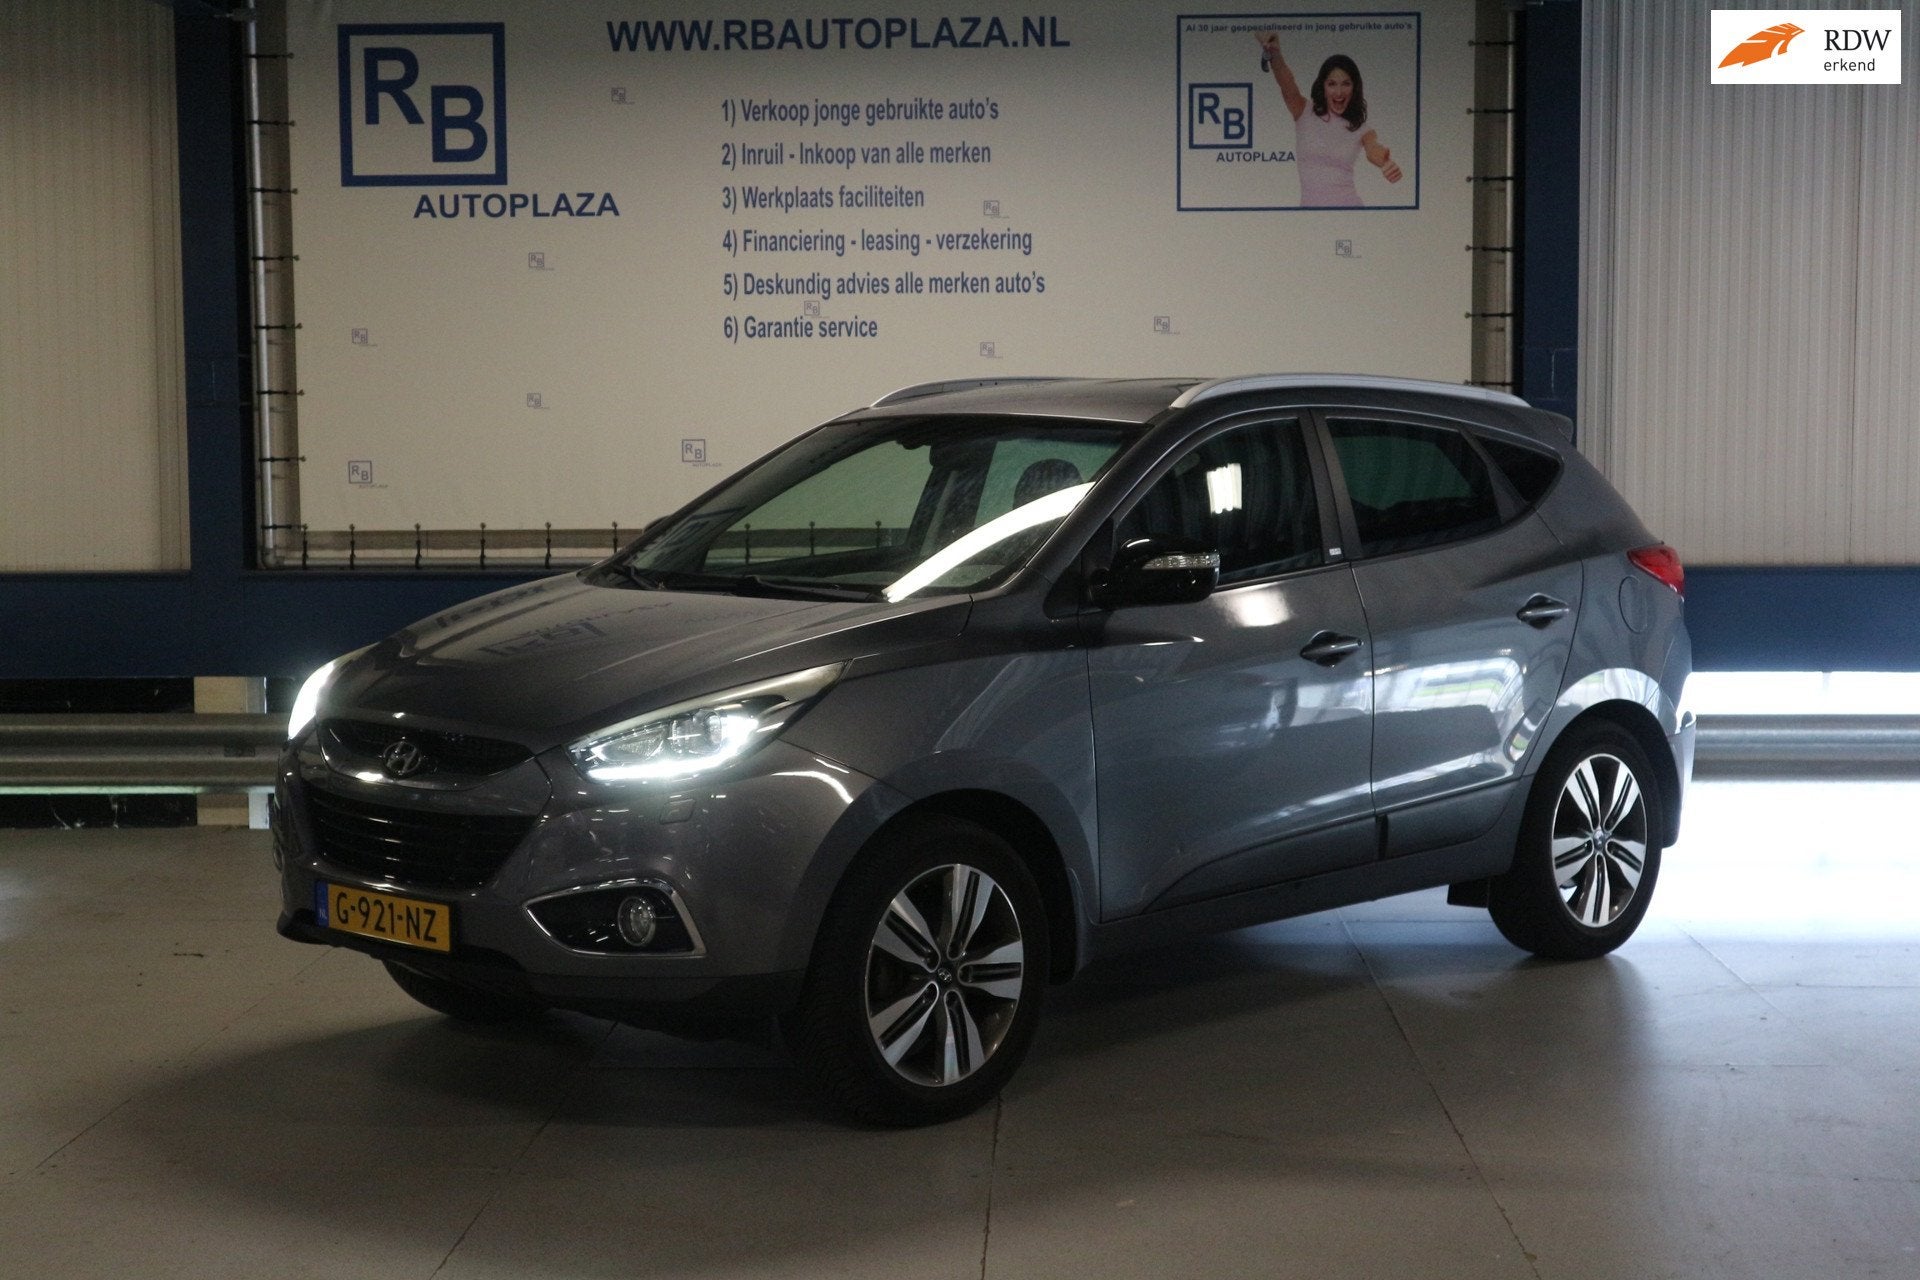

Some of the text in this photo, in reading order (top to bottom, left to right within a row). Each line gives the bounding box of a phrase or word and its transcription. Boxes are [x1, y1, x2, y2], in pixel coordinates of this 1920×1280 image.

[605, 15, 1071, 53] WWW.RBAUTOPLAZA.NL
[1338, 22, 1382, 32] gebruikte
[363, 47, 488, 163] RB
[721, 96, 1000, 128] 1) Verkoop jonge gebruikte auto's
[1197, 91, 1246, 140] RB
[721, 142, 737, 171] 2)
[741, 142, 784, 166] Inruil
[799, 141, 857, 170] Inkoop
[860, 146, 891, 165] van
[895, 141, 925, 164] alle
[929, 140, 991, 164] merken
[1216, 150, 1296, 163] AUTOPLAZA
[413, 192, 620, 219] AUTOPLAZA
[722, 184, 925, 215] 3) Werkplaats faciliteiten
[722, 229, 738, 258] 4)
[742, 228, 846, 258] Financiering
[861, 228, 921, 257] leasing
[935, 227, 1033, 257] verzekering
[723, 270, 1046, 301] 5) Deskundig advies alle merken auto's
[723, 315, 878, 344] 6) Garantie service
[336, 891, 437, 943] G-921-NZ
